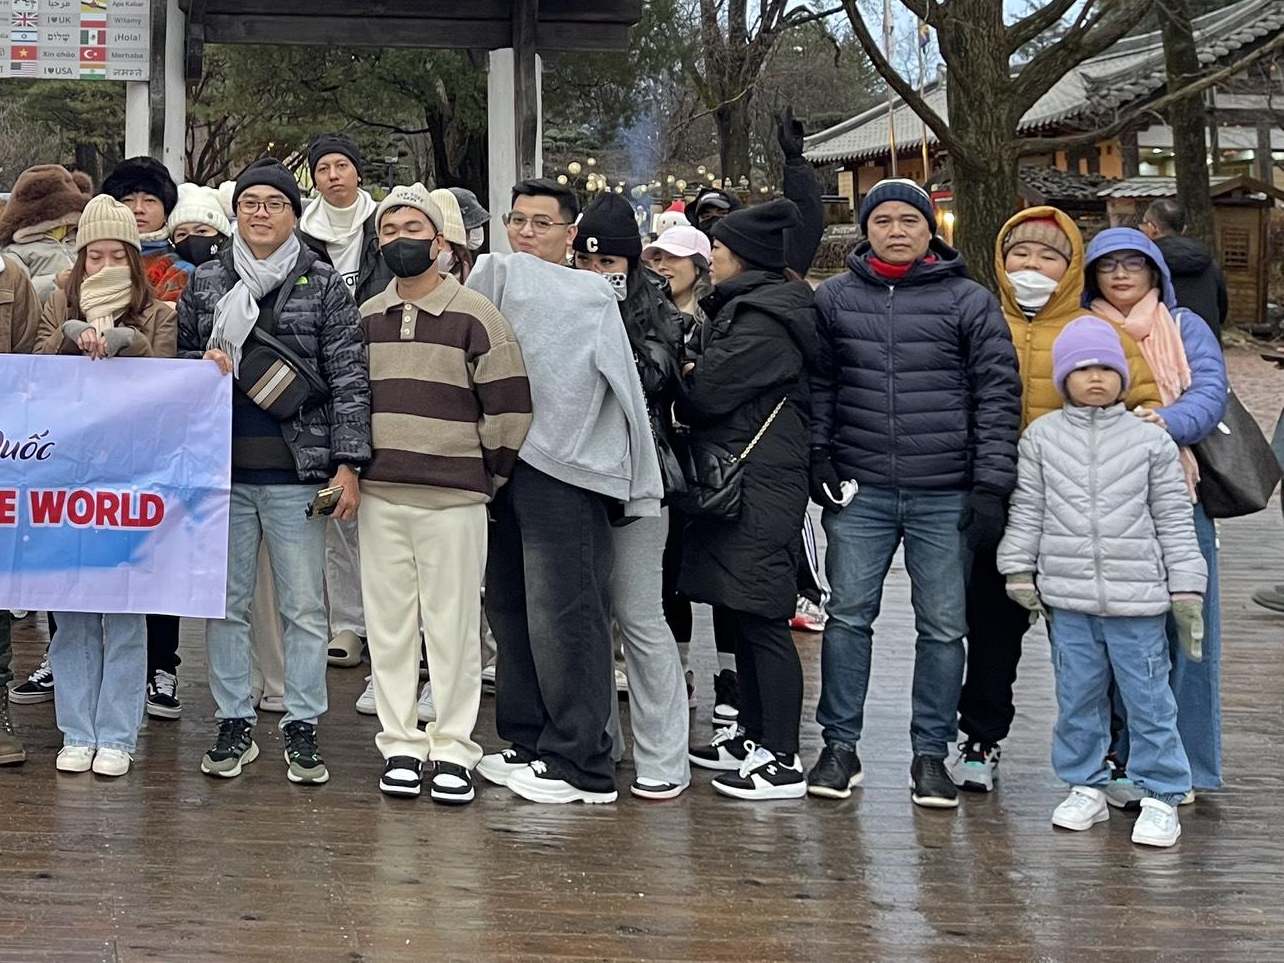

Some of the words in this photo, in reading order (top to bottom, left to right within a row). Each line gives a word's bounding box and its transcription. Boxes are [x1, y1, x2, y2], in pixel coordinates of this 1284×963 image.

[59, 16, 71, 24] UK
[586, 236, 599, 253] C
[29, 489, 166, 529] WORLD
